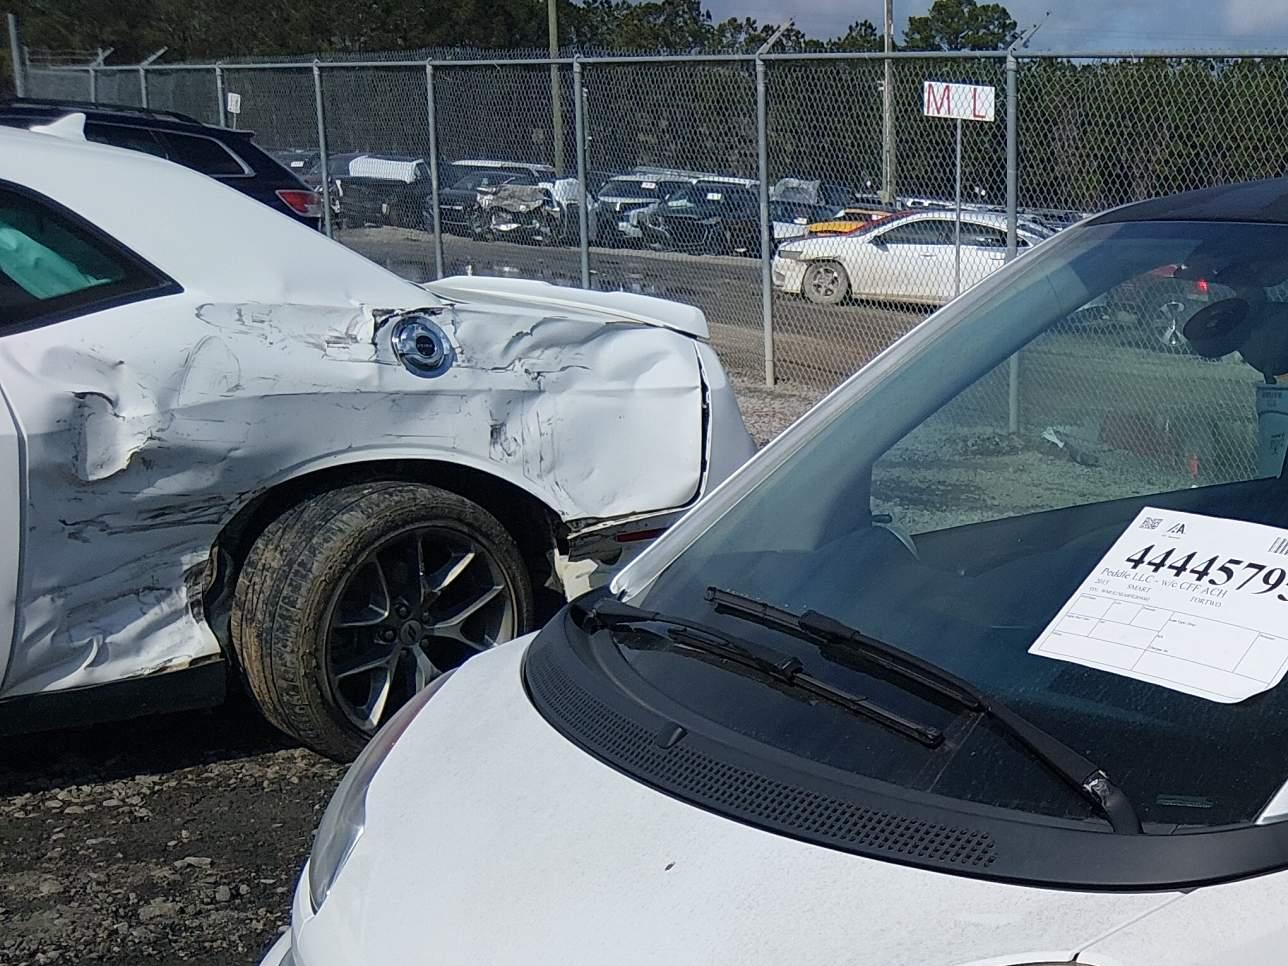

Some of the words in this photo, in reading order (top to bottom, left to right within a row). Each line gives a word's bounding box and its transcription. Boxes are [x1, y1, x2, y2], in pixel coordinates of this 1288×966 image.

[926, 83, 951, 115] M
[973, 87, 987, 118] L
[1101, 567, 1131, 579] Peddle
[1132, 572, 1155, 584] LLC
[1201, 586, 1228, 599] ACH
[1127, 583, 1152, 593] SMART
[1190, 595, 1222, 608] FORTWO
